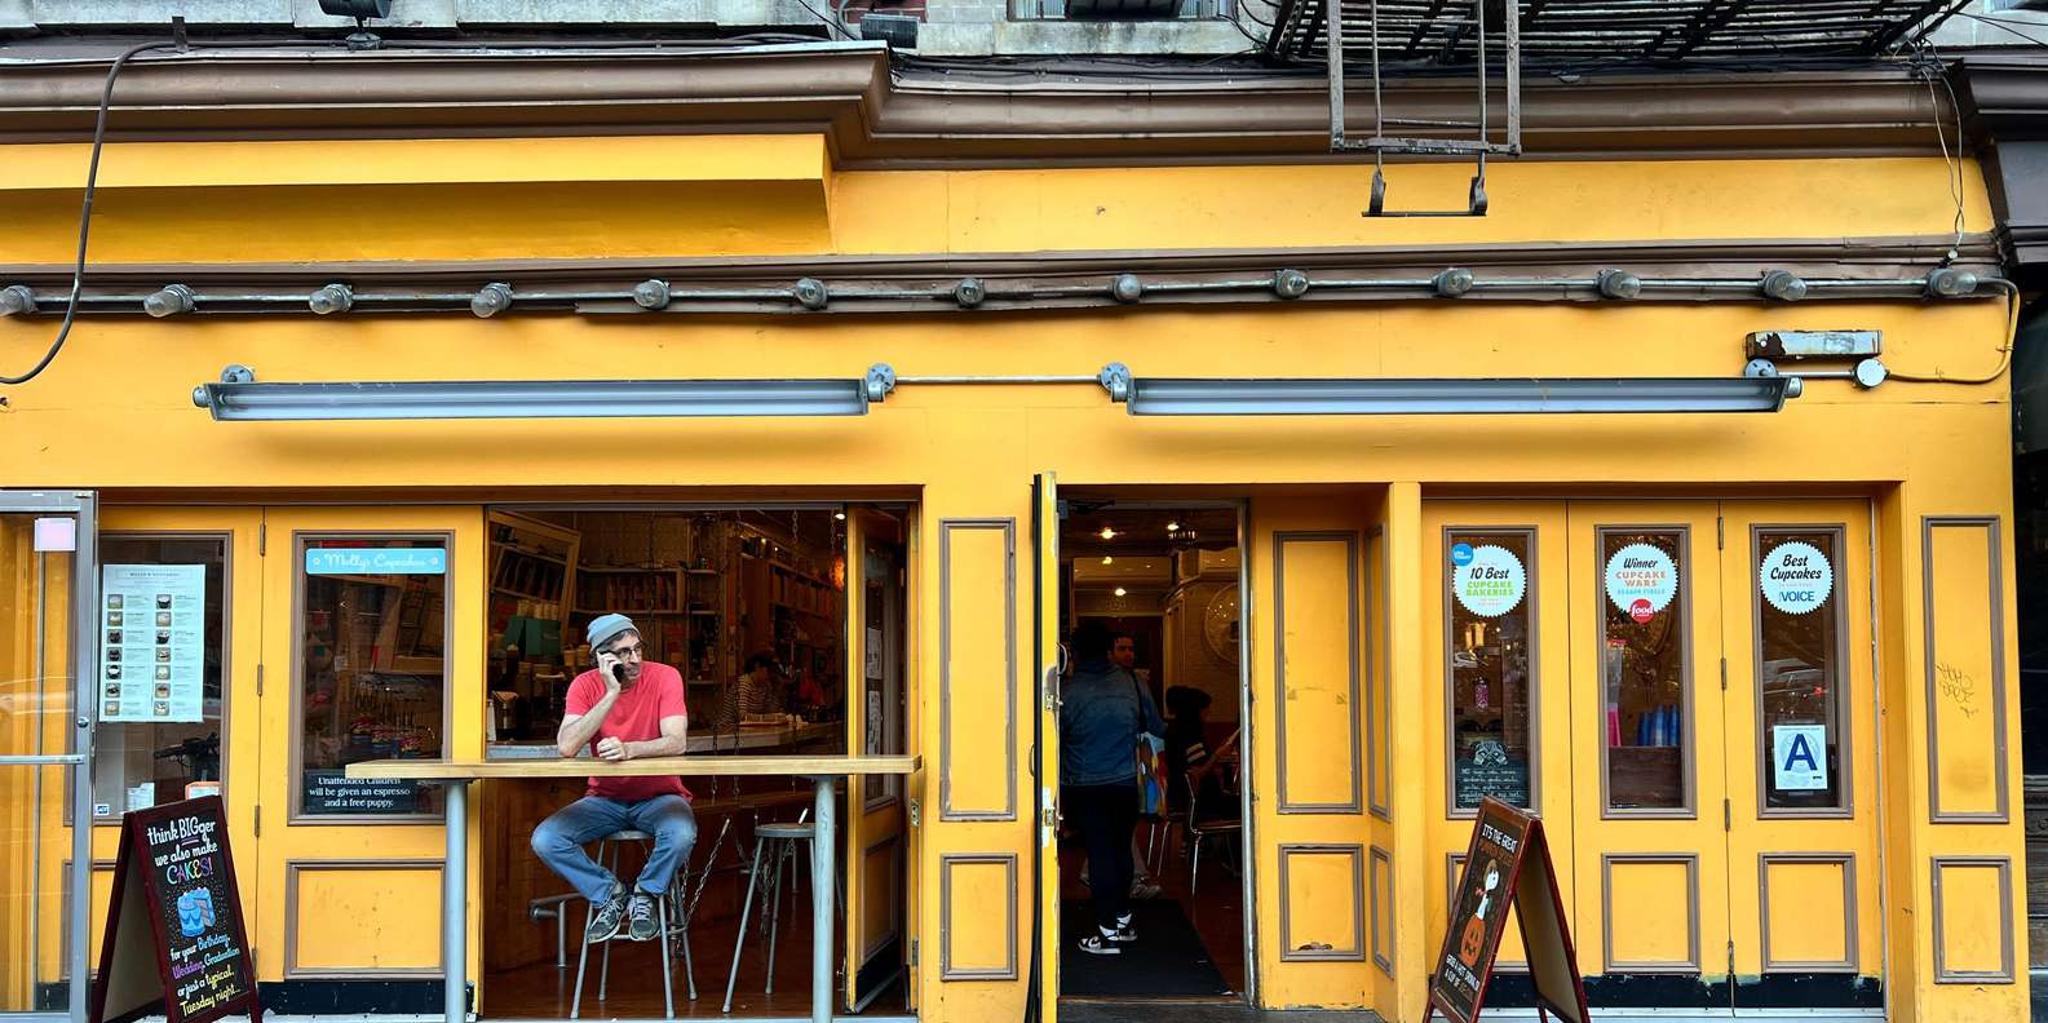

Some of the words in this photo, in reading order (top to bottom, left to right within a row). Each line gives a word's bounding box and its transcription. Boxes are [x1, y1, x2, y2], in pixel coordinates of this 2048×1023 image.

[1623, 557, 1659, 568] Winner
[1782, 554, 1809, 567] Best
[1470, 567, 1483, 580] 10
[1485, 566, 1510, 580] Best
[1615, 571, 1666, 579] CUPCAKE
[1770, 567, 1822, 581] Cupcakes
[1780, 591, 1815, 602] VOICE
[1631, 603, 1654, 617] food
[1784, 733, 1818, 771] A
[309, 788, 323, 796] will
[325, 788, 336, 796] be
[337, 788, 360, 797] given
[373, 789, 411, 797] espresso
[324, 799, 341, 807] and
[349, 799, 365, 807] free
[147, 820, 179, 845] think
[178, 816, 216, 842] BIGger
[155, 854, 169, 867] we
[170, 844, 191, 863] also
[192, 838, 218, 857] make
[166, 857, 214, 885] CAKES!
[170, 948, 181, 961] for
[182, 945, 197, 962] your
[184, 979, 200, 1000] just
[199, 979, 206, 988] a
[180, 994, 216, 1017] Tuesday
